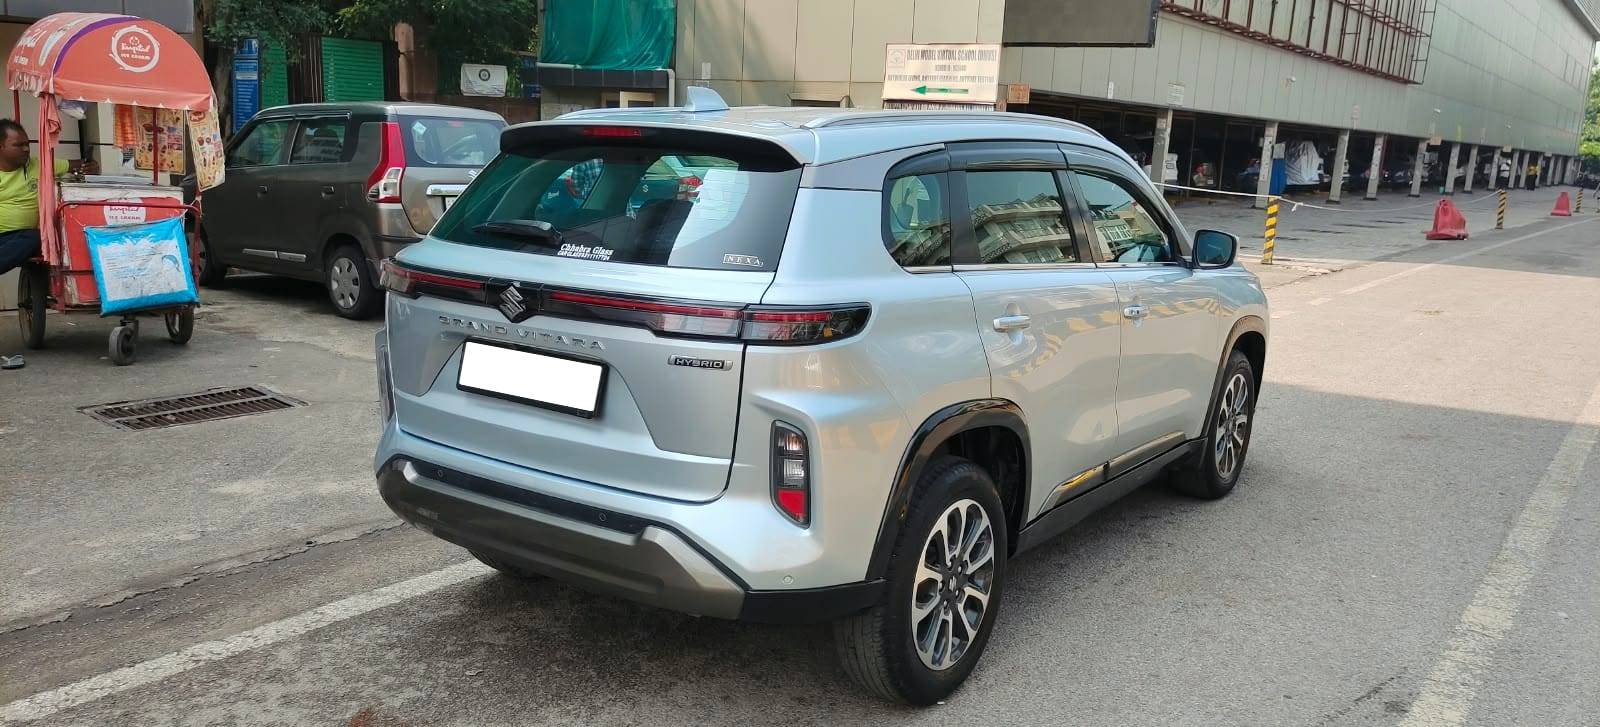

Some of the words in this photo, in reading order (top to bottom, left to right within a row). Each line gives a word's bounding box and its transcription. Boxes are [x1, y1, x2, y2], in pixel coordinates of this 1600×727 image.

[958, 49, 977, 61] SCHOOL
[560, 243, 592, 253] Chhabra
[592, 246, 614, 256] Glass
[724, 254, 761, 266] NEXA
[438, 315, 508, 335] GRAND
[516, 328, 607, 350] VITARA
[675, 358, 723, 368] HYBRID
